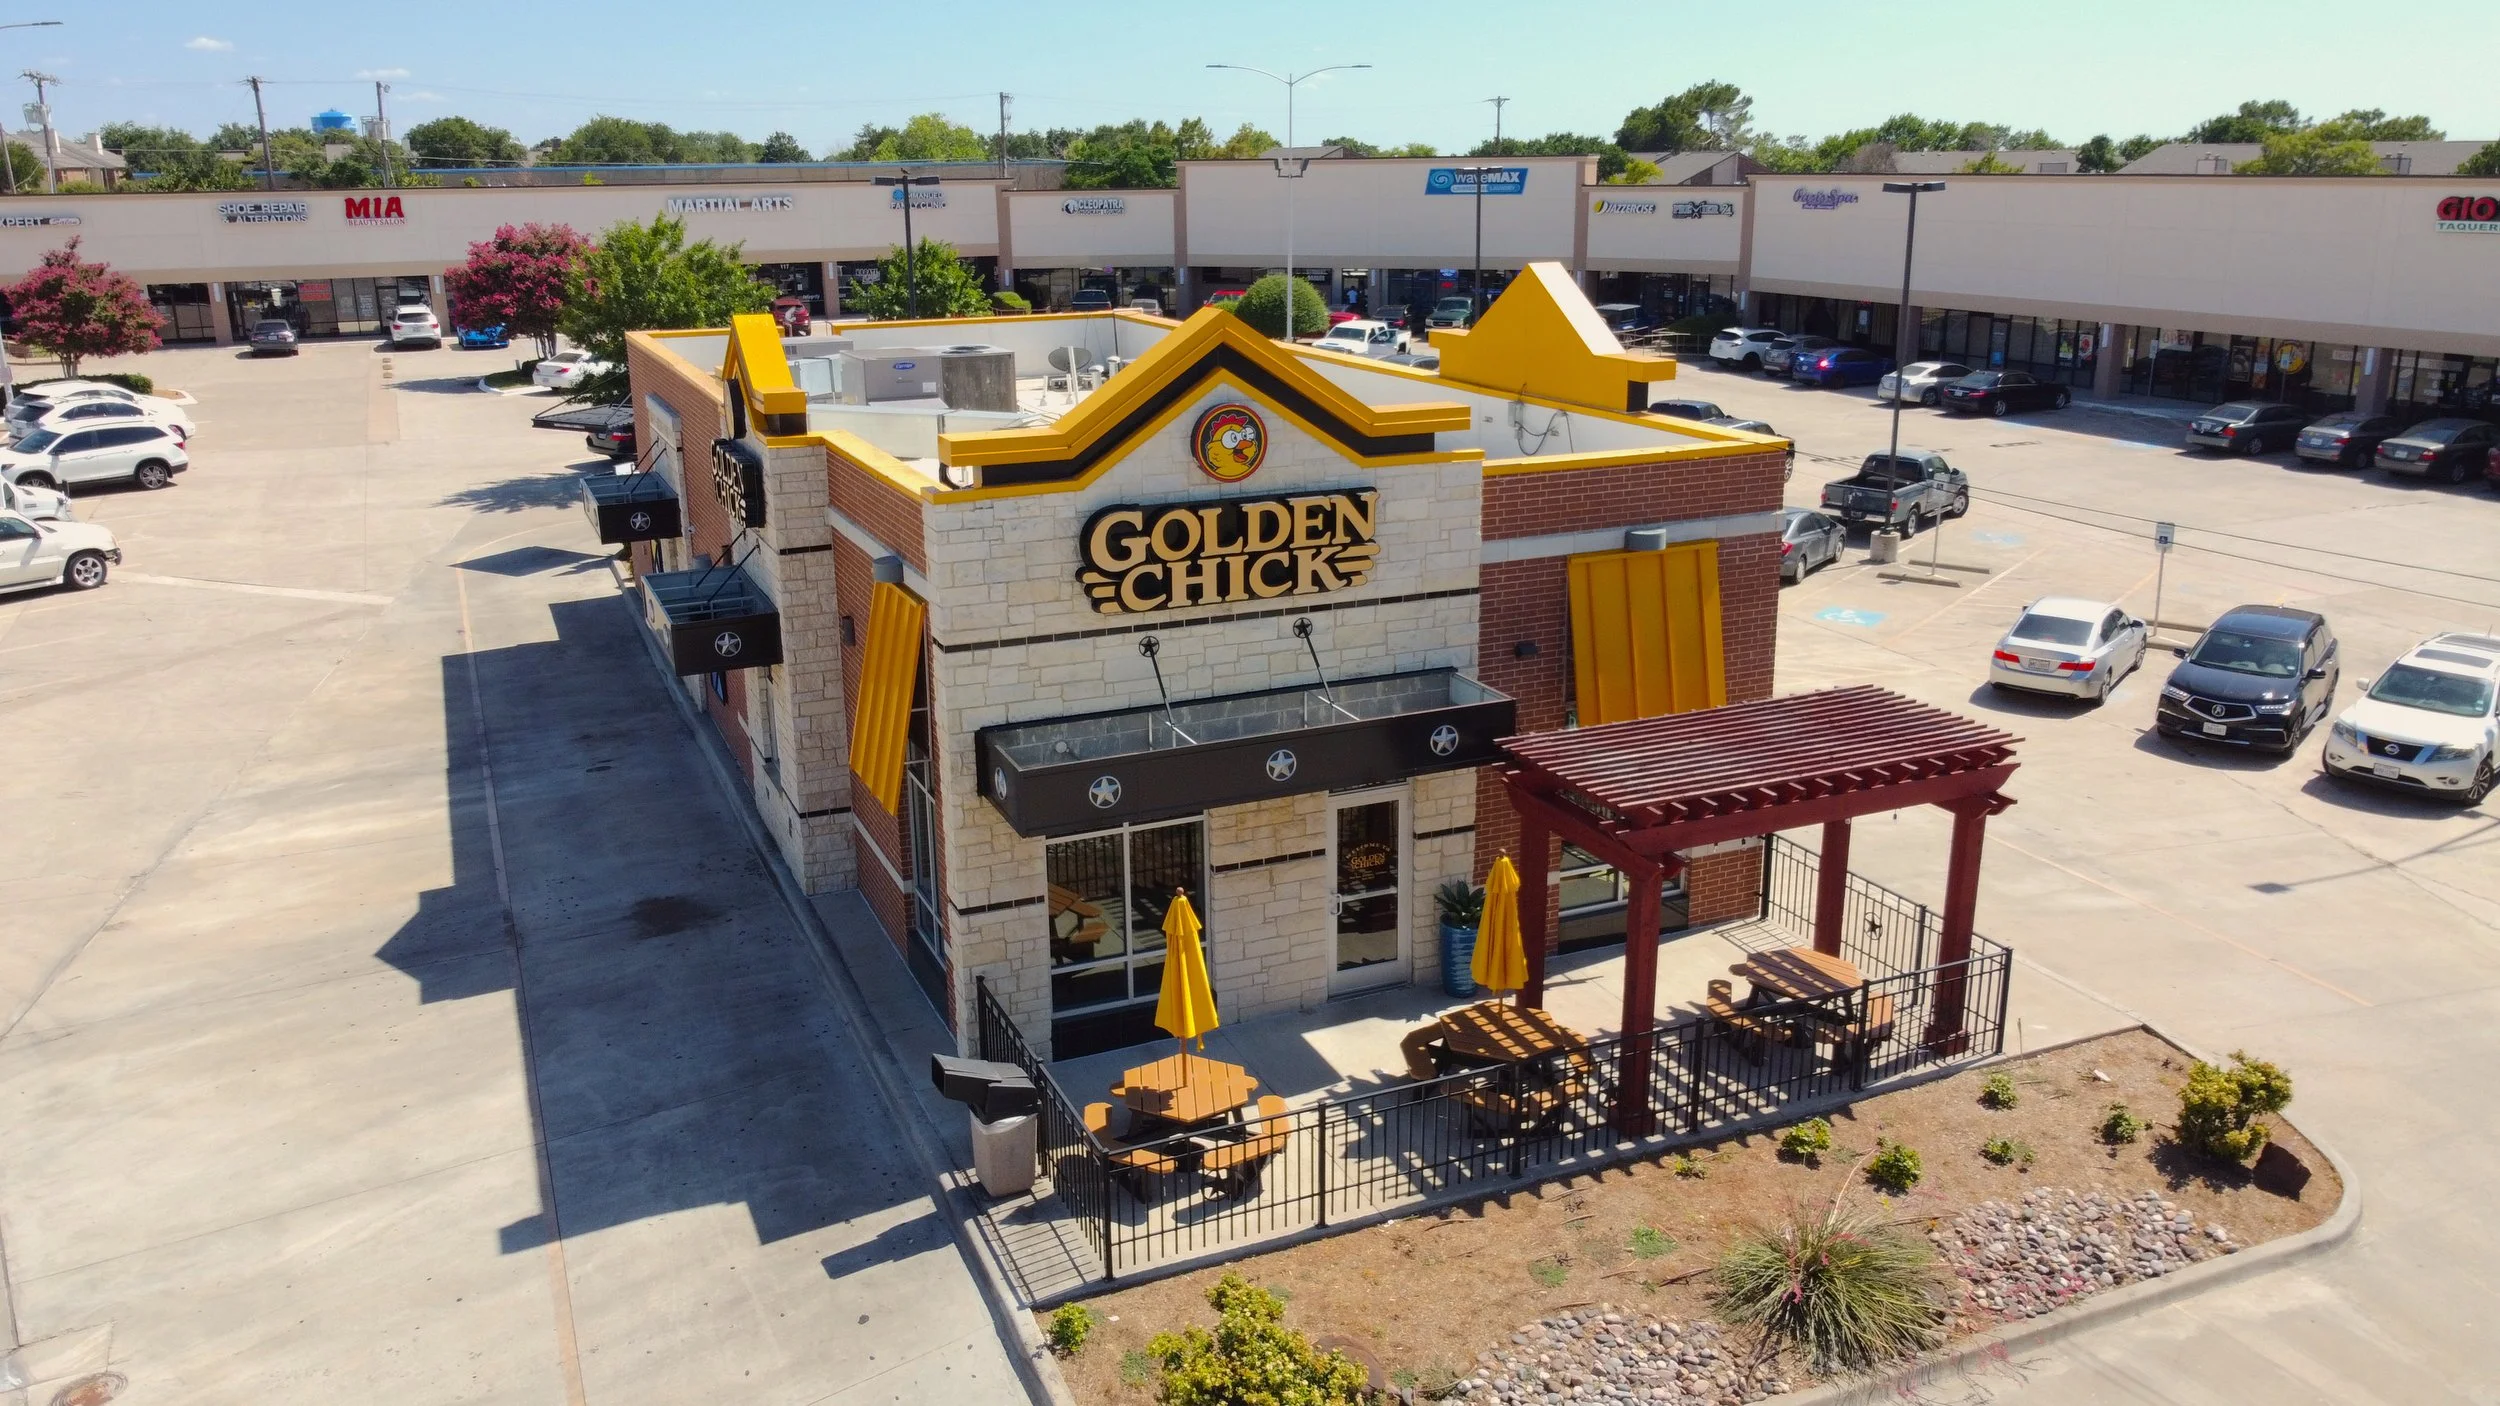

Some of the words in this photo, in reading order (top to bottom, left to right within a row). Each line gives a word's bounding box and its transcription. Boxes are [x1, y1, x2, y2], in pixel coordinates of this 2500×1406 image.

[219, 203, 255, 214] SHOE
[261, 202, 307, 213] REPAIR
[344, 196, 404, 219] MIA
[667, 199, 744, 213] MARTIAL
[751, 197, 793, 211] ARTS
[1079, 199, 1124, 209] CLEOPATRA
[1607, 203, 1655, 214] JAZZERCISE
[236, 214, 307, 223] ALTERATIONS
[711, 439, 745, 495] GOLDEN
[715, 475, 745, 528] CHICK
[1090, 490, 1380, 572] GOLDEN
[1120, 545, 1347, 612] CHICK
[1346, 843, 1379, 859] WELCOME
[1351, 853, 1385, 865] GOLDEN
[1355, 860, 1380, 869] CHICK
